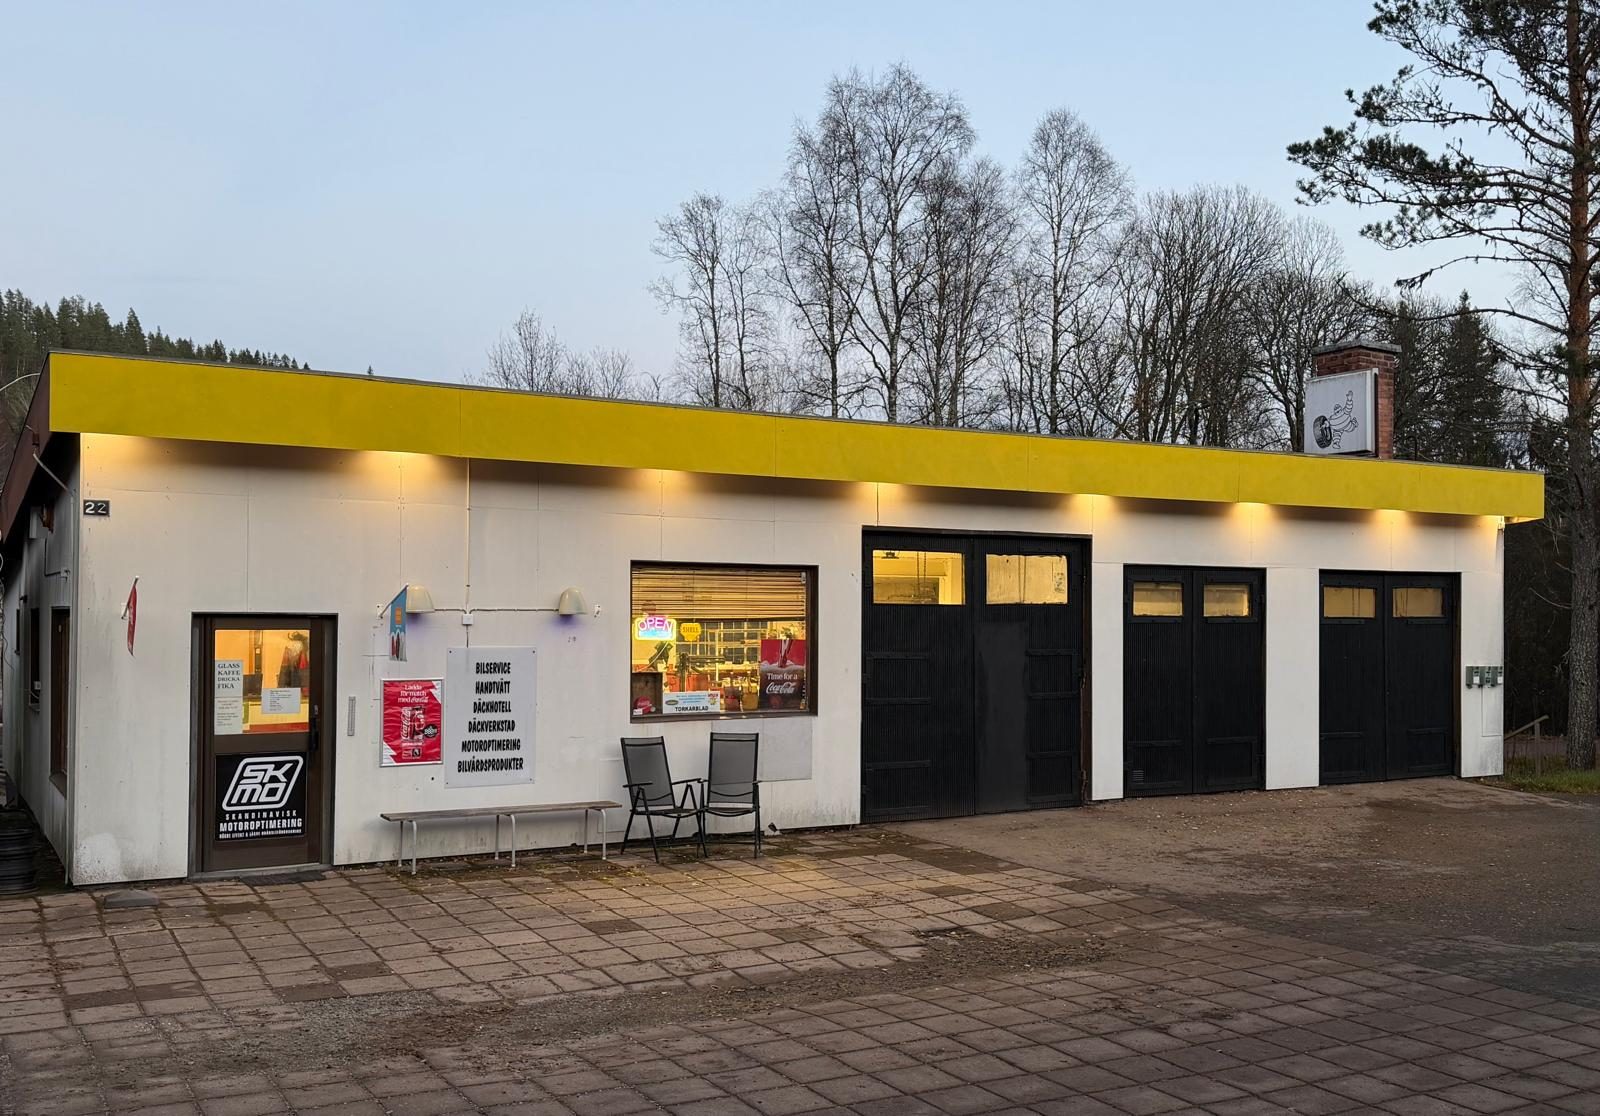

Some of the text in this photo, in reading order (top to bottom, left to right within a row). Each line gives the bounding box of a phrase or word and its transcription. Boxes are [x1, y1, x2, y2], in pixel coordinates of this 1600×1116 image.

[85, 501, 106, 513] 22
[638, 616, 673, 632] OPEN
[475, 662, 511, 674] BILSERVICE
[475, 678, 511, 694] HANDTVÄTT
[473, 698, 512, 713] DÄCKHOTELL
[468, 717, 515, 733] DÄCKVERKSTAD
[461, 739, 521, 752] MOTOROPTIMERING
[457, 755, 524, 773] BILVÅRDSPRODUKTER
[225, 810, 297, 821] SKANDINAVISK
[219, 818, 303, 832] MOTOROPTIMERING
